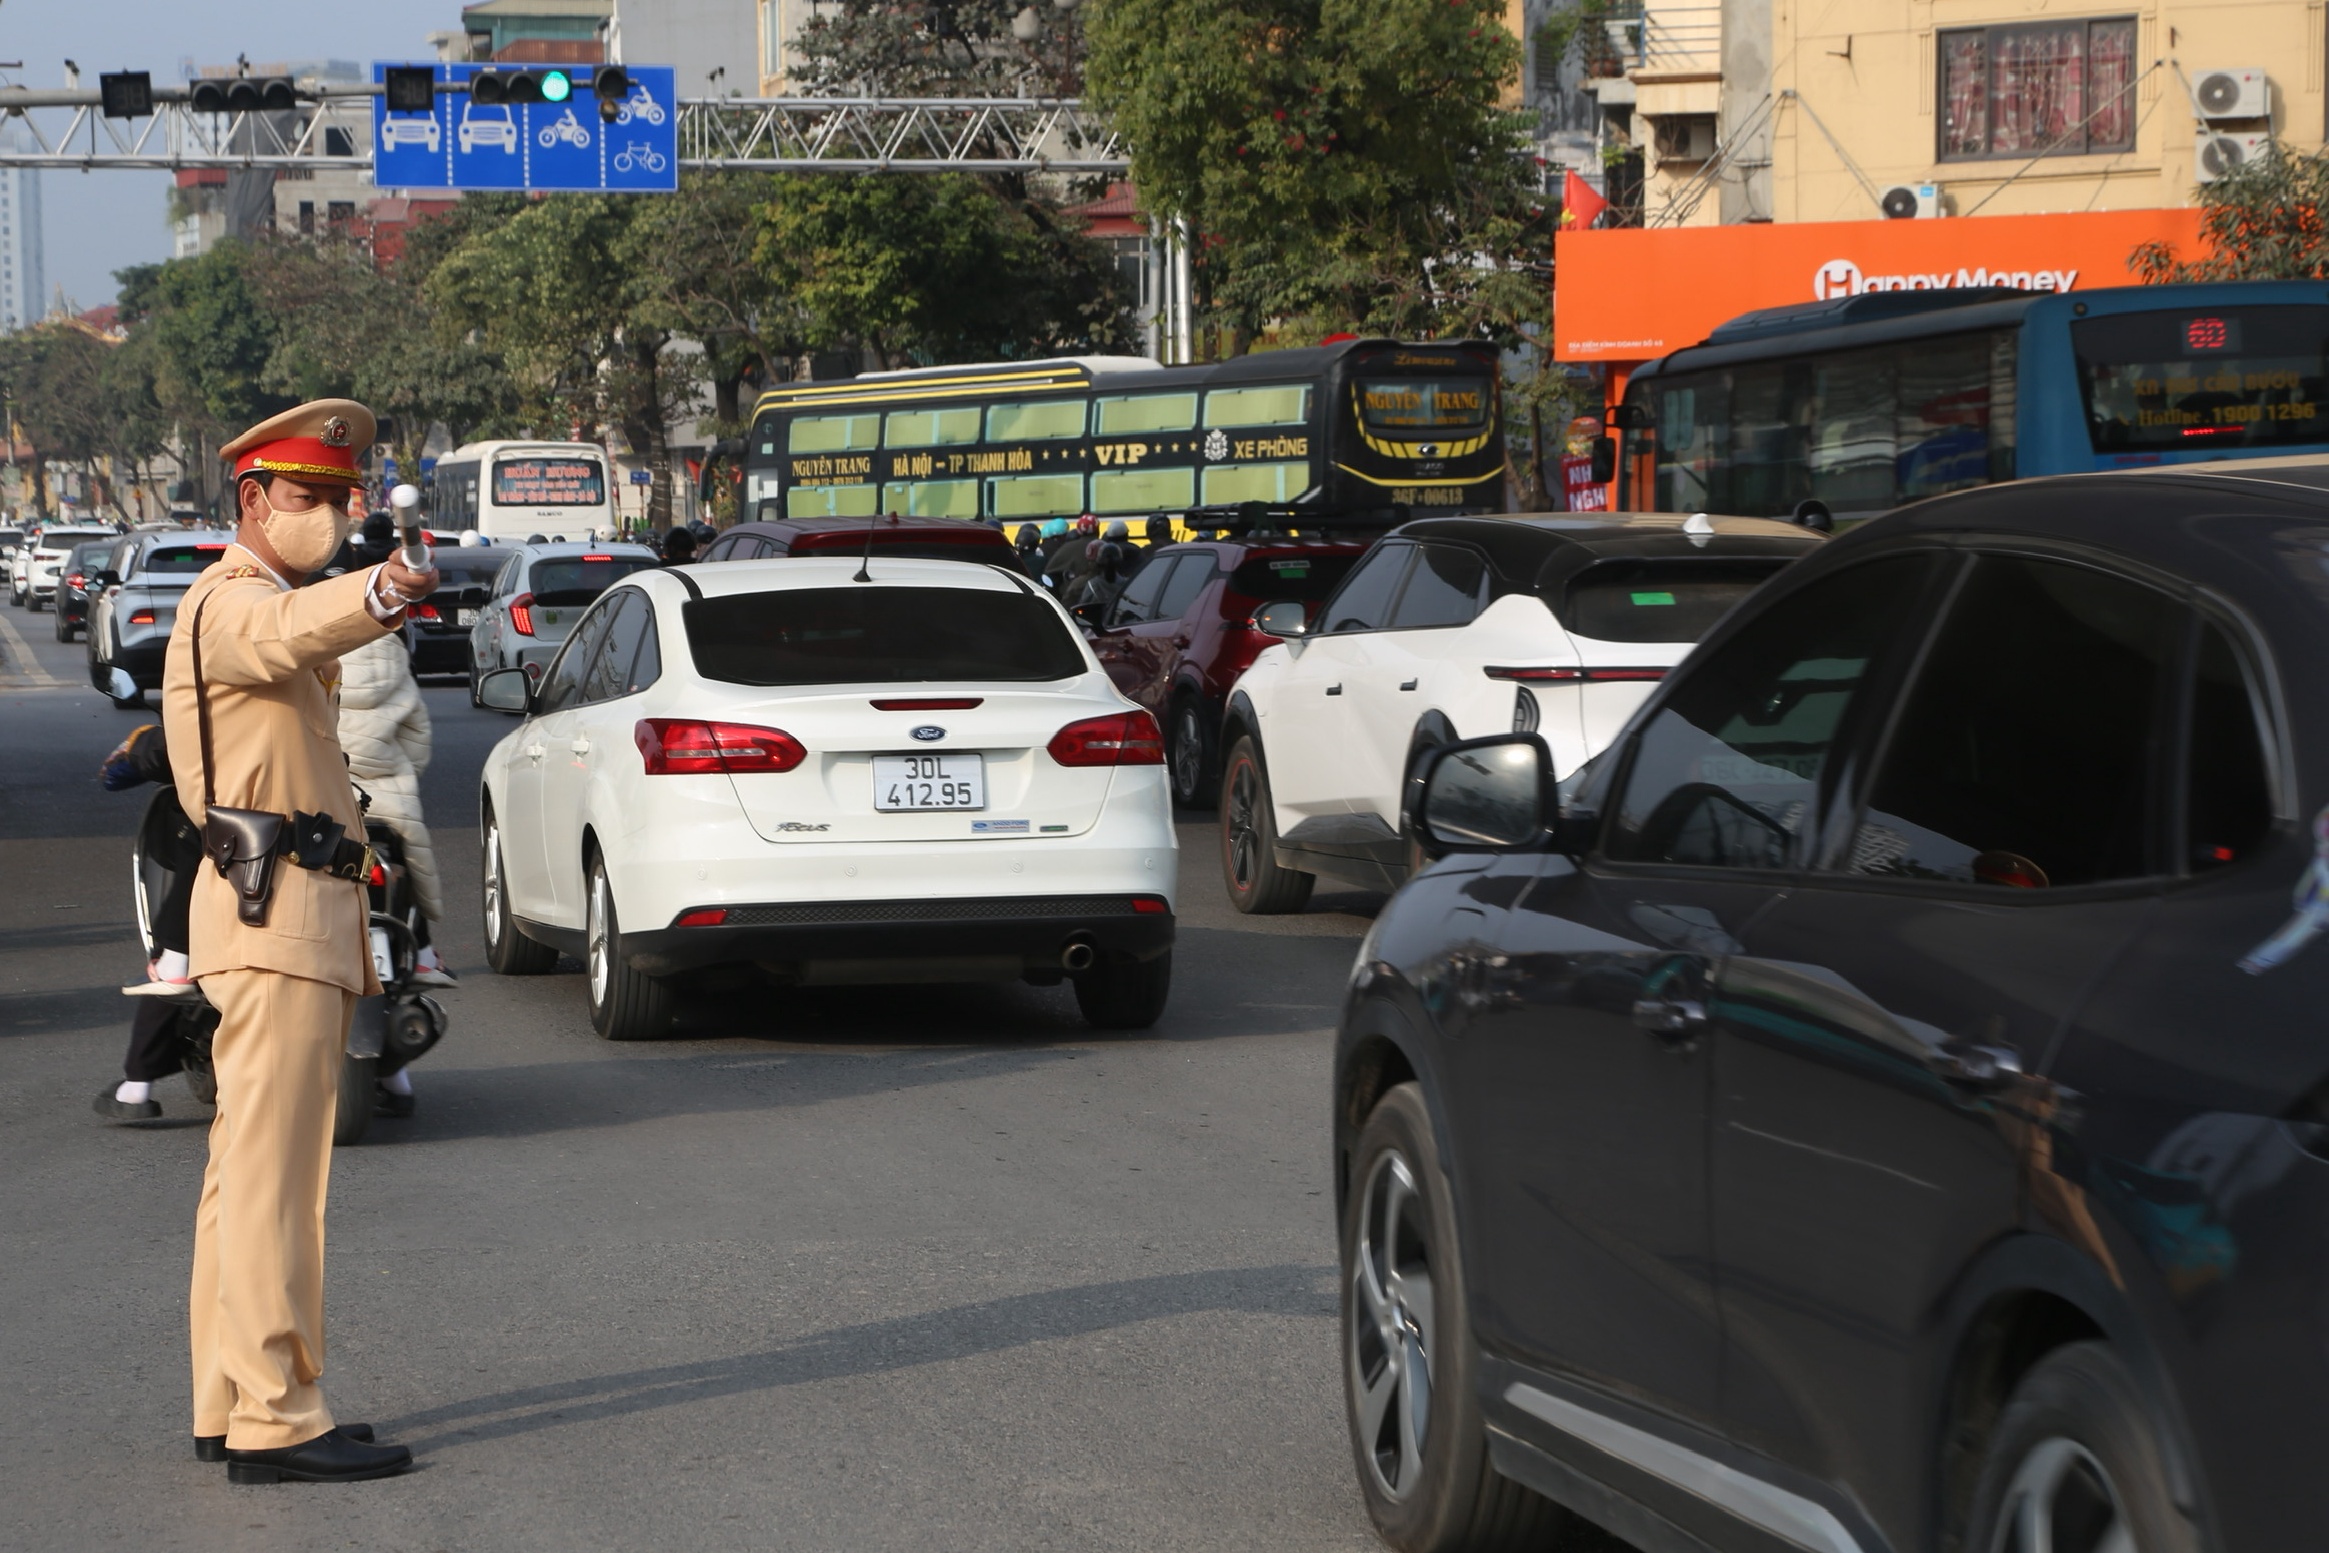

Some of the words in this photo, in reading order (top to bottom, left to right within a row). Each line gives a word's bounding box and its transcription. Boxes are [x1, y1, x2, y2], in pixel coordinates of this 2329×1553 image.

[1956, 267, 2077, 293] Money
[2187, 318, 2227, 348] 60
[1433, 391, 1479, 409] TRANG
[2211, 405, 2262, 424] 1900
[2266, 402, 2317, 420] 1296
[1094, 443, 1148, 466] VIP
[1234, 440, 1255, 459] XE
[1257, 434, 1308, 458] PHÒNG
[792, 455, 833, 477] NGUYÊN
[834, 456, 871, 475] TRANG
[893, 453, 909, 477] HÀ
[911, 452, 933, 479] NỘI
[949, 453, 964, 474] TP
[966, 452, 1005, 473] THANH
[1007, 447, 1033, 471] HÓA
[1568, 464, 1593, 484] NH
[917, 728, 941, 740] Ford
[905, 757, 951, 779] 30L
[887, 782, 972, 807] 412.95
